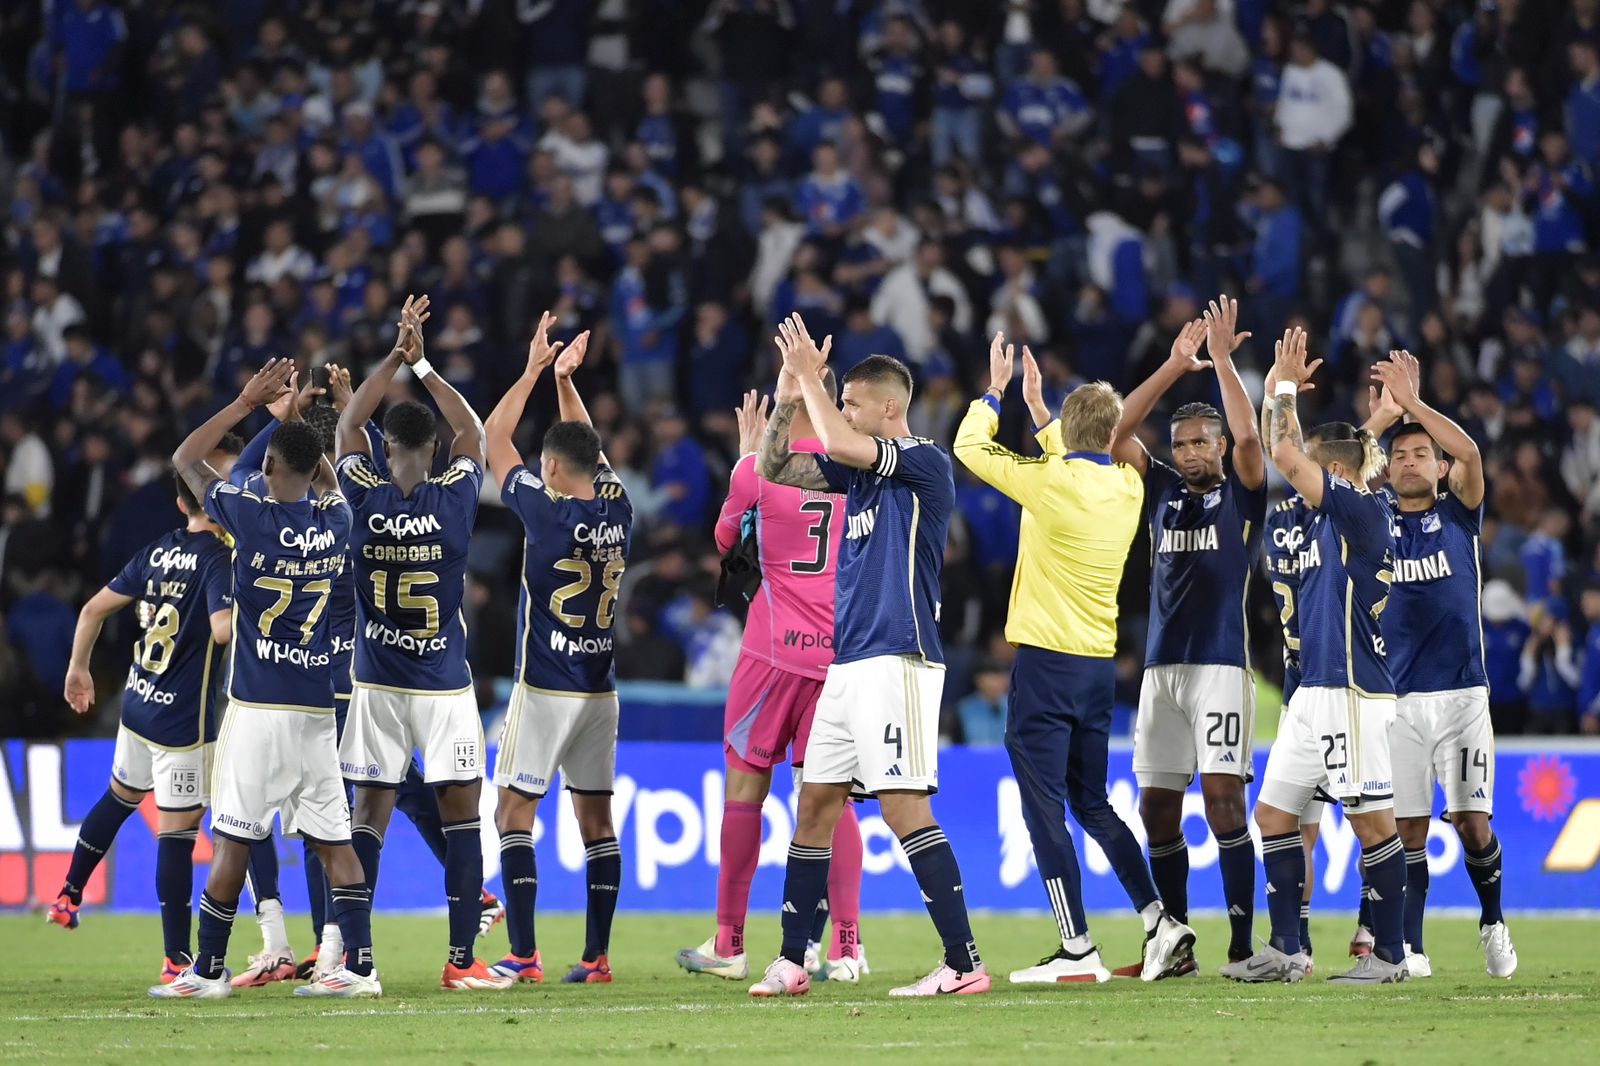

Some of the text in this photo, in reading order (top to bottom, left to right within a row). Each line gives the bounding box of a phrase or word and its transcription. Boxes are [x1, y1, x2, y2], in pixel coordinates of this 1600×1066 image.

[363, 544, 443, 562] CORDOBA
[253, 577, 332, 645] 77
[370, 570, 440, 638] 15
[548, 559, 625, 629] 28
[884, 723, 902, 759] 4
[1206, 712, 1240, 746] 20
[1321, 732, 1348, 770] 23
[1461, 747, 1487, 782] 14
[217, 813, 252, 832] Allianz
